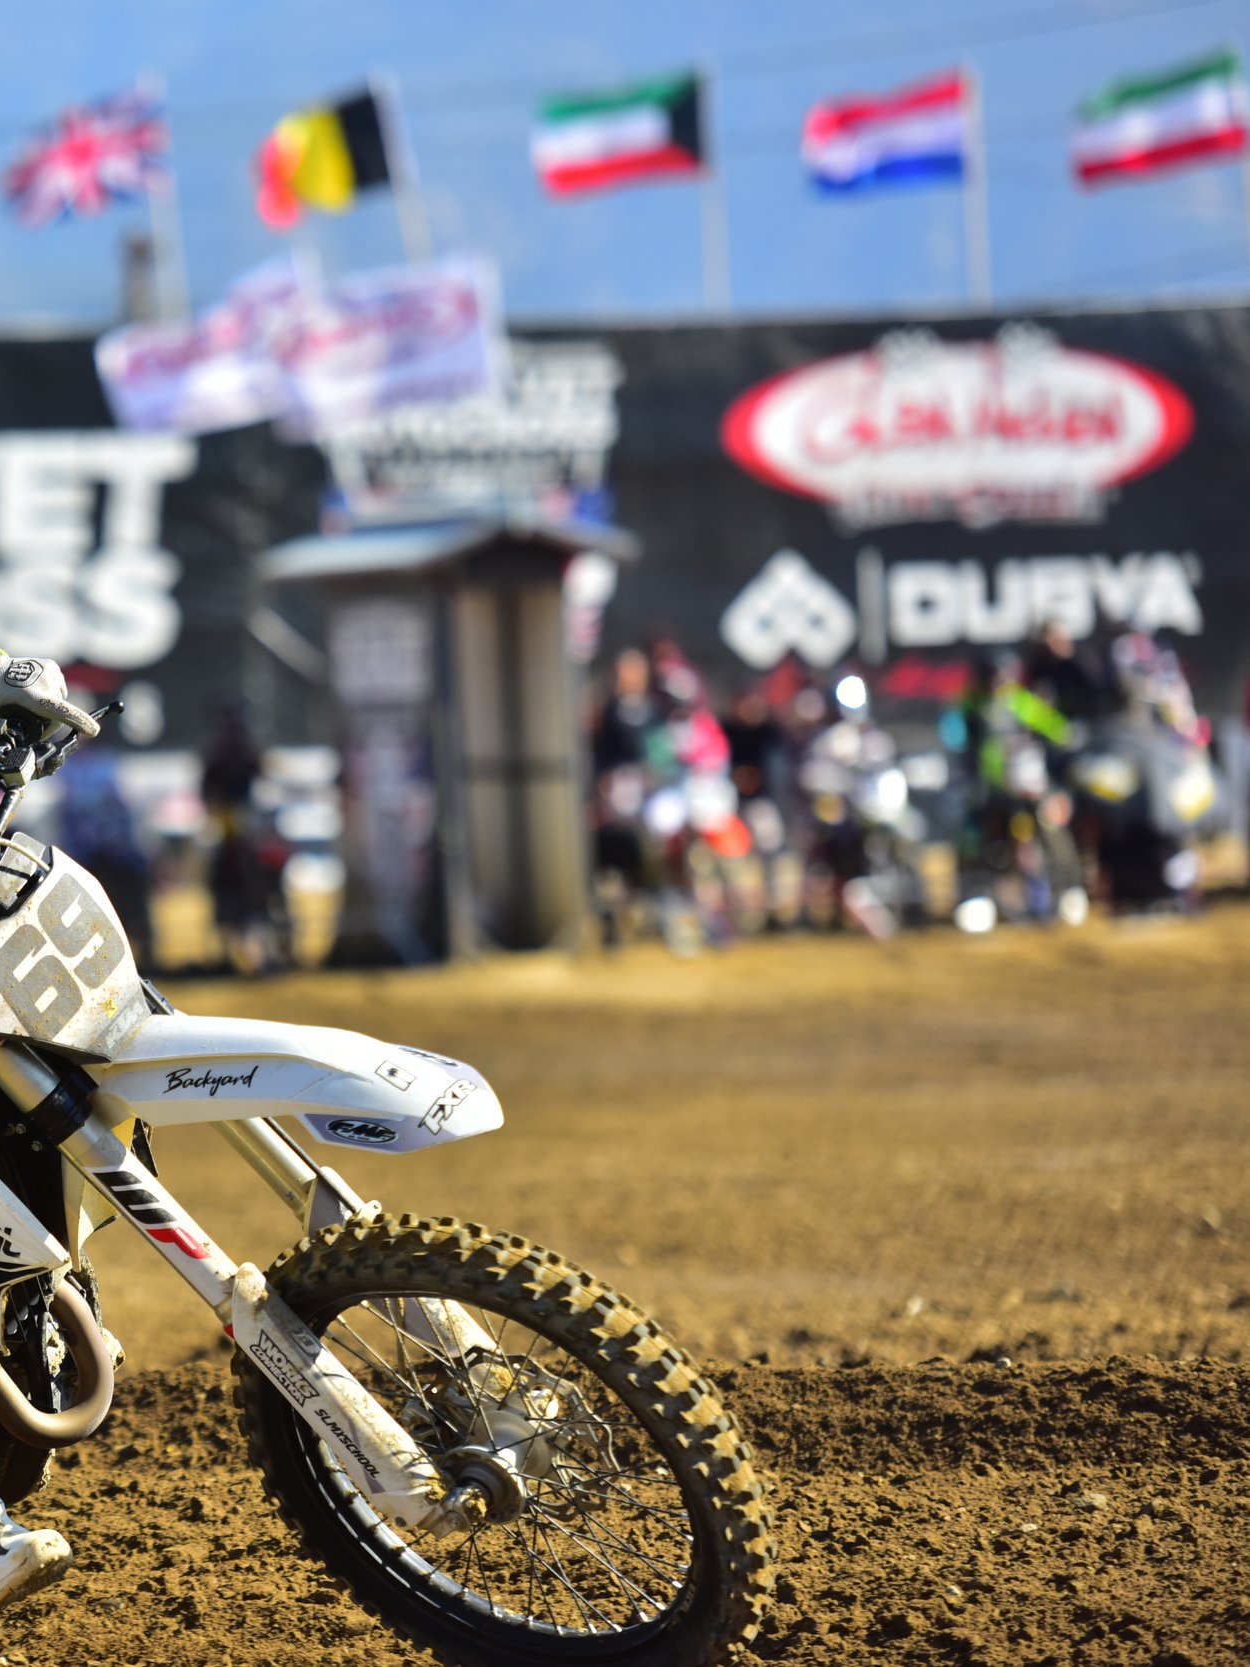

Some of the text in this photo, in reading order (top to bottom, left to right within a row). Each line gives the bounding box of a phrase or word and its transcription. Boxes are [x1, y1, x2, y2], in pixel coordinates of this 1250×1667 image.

[887, 550, 1203, 647] DUBYA
[162, 1064, 260, 1096] Backyard
[417, 1078, 478, 1136] FXR
[328, 1121, 397, 1140] FMF
[251, 1344, 305, 1406] CONNECTION
[314, 1408, 380, 1480] SLMXSCHOOL
